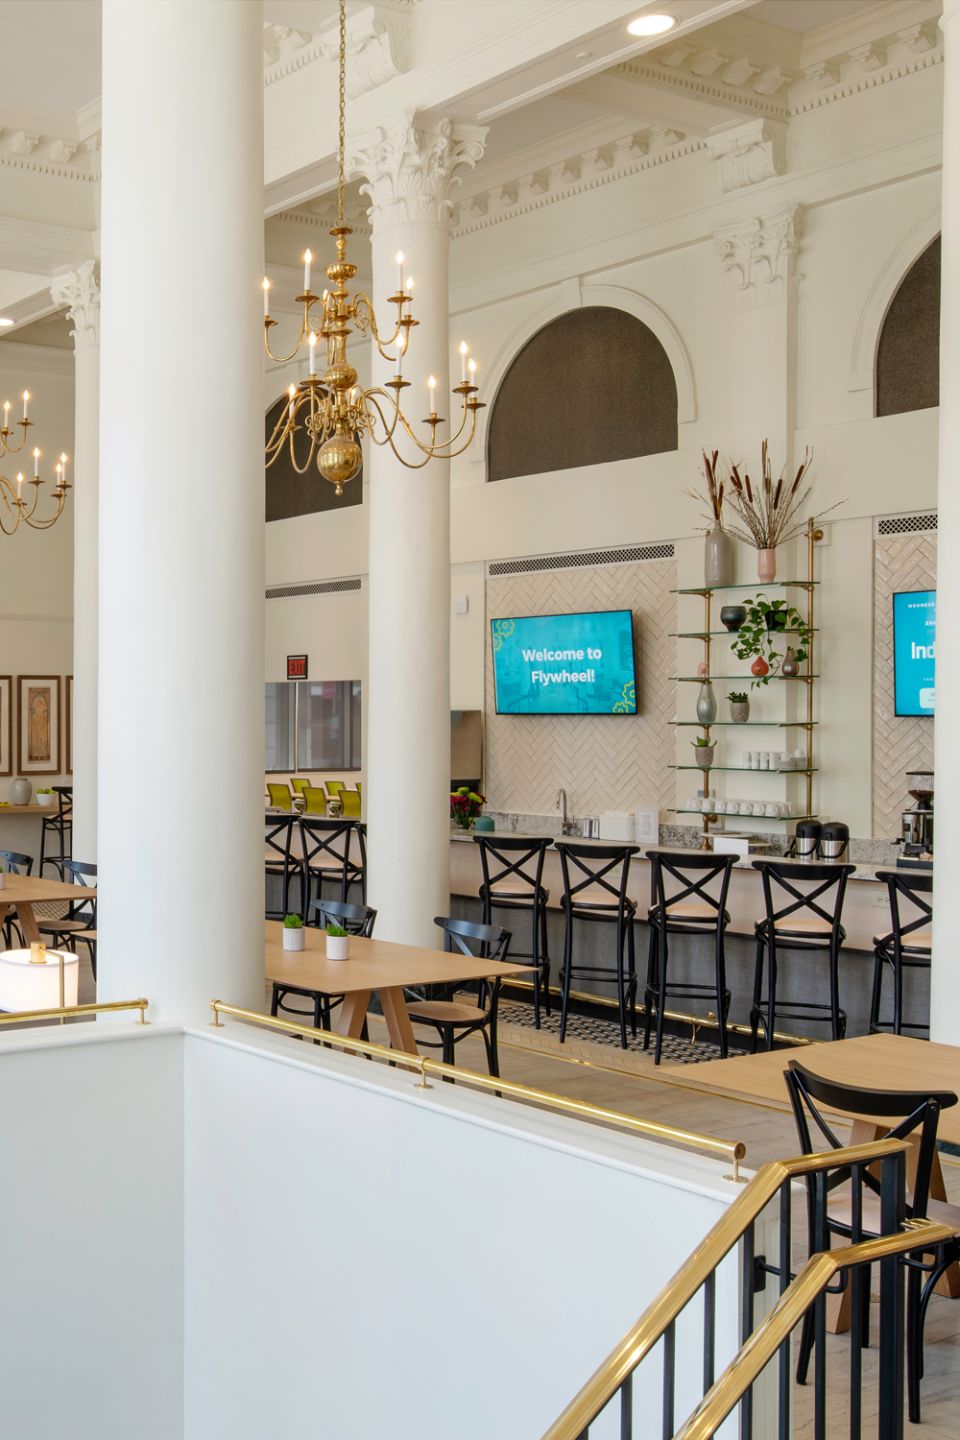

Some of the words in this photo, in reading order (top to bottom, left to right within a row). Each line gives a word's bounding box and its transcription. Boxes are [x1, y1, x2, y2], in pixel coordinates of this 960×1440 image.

[521, 648, 585, 662] Welcome
[586, 647, 603, 660] to
[531, 669, 596, 687] Flywheel!
